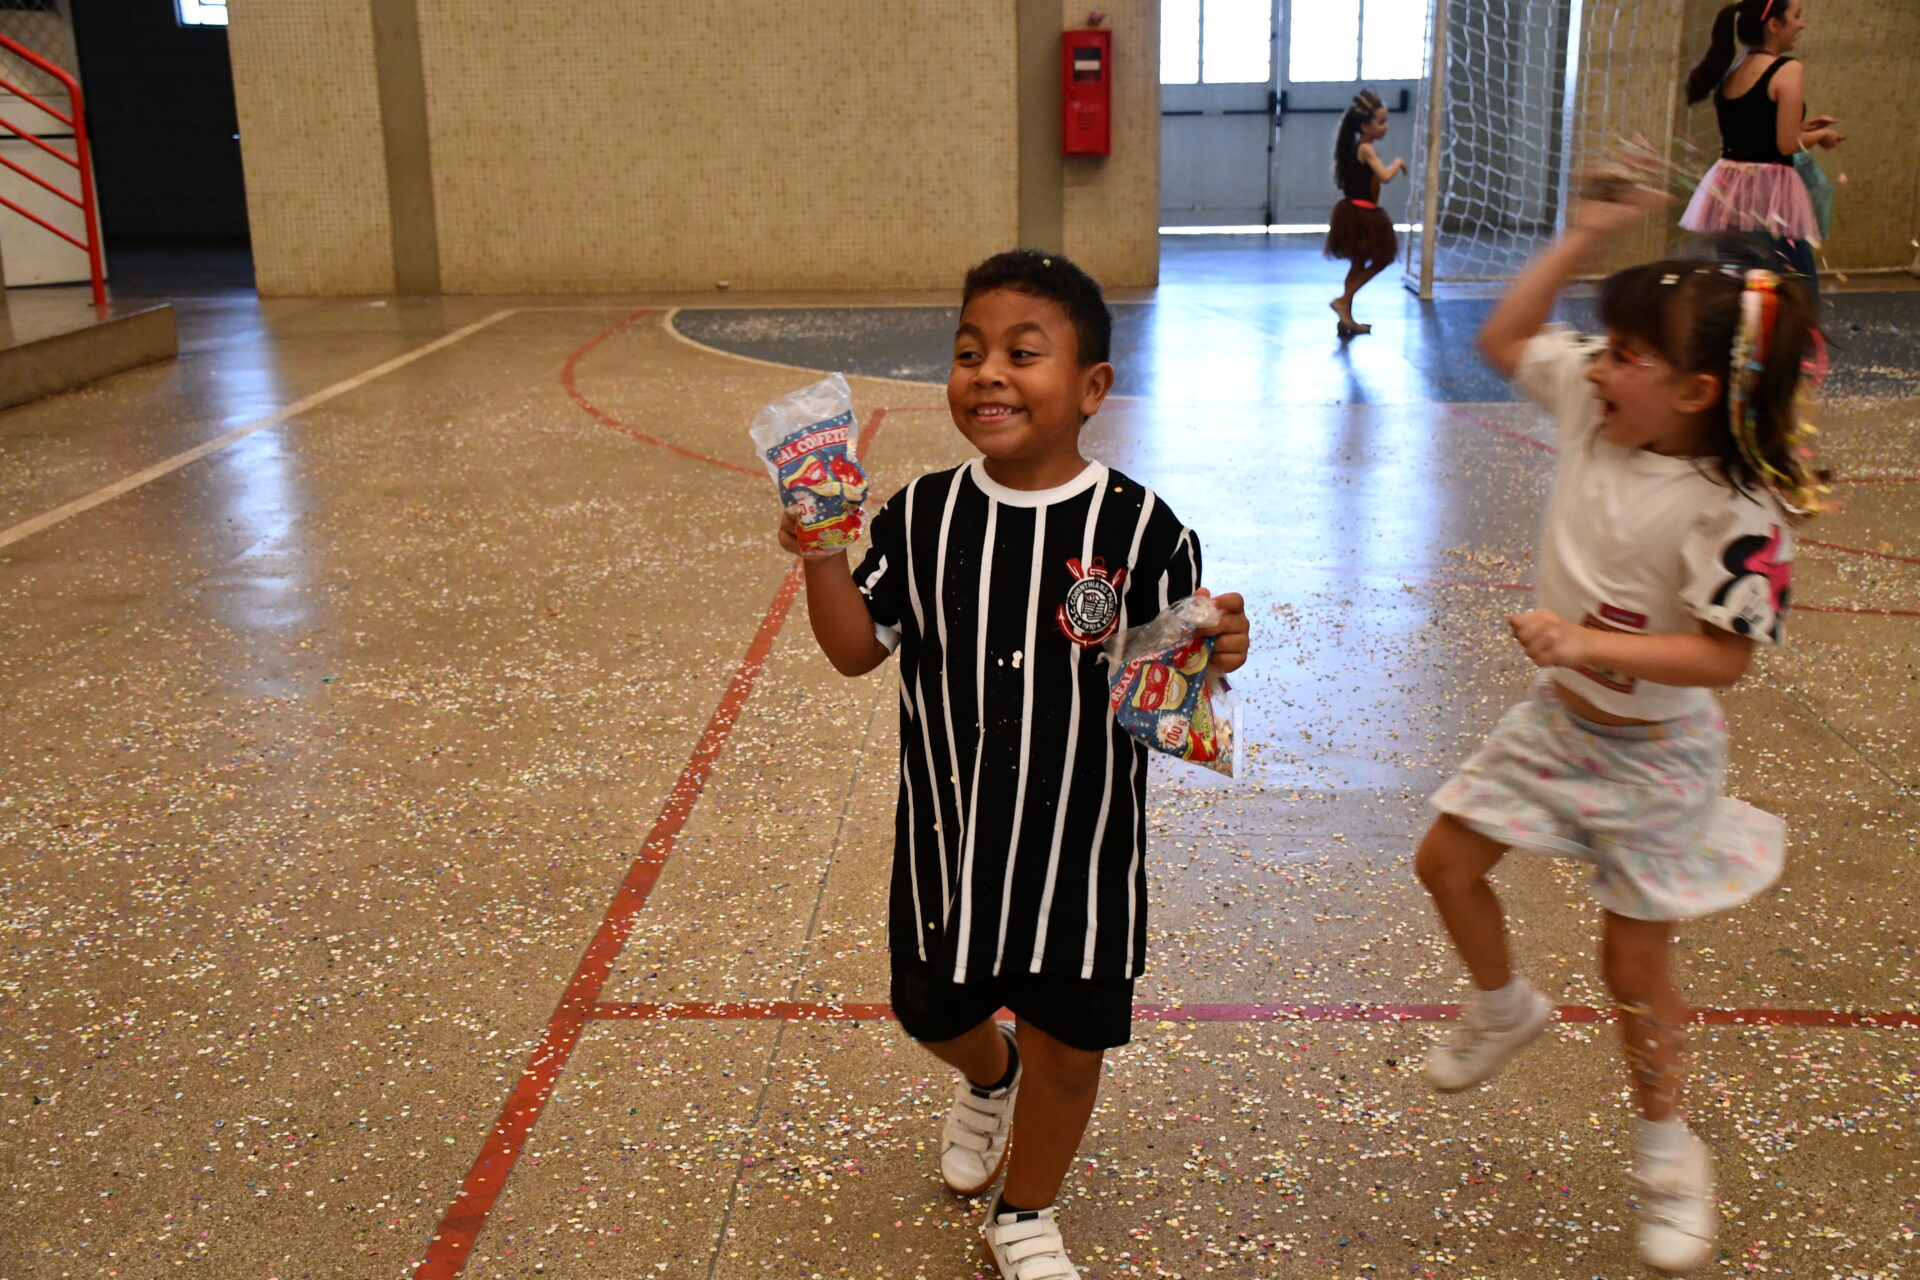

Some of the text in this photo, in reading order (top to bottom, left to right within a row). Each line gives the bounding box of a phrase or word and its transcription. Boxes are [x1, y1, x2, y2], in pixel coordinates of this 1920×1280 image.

[1070, 581, 1109, 605] CORINTHIANS
[1111, 671, 1135, 702] REAL
[1164, 726, 1183, 747] 100
